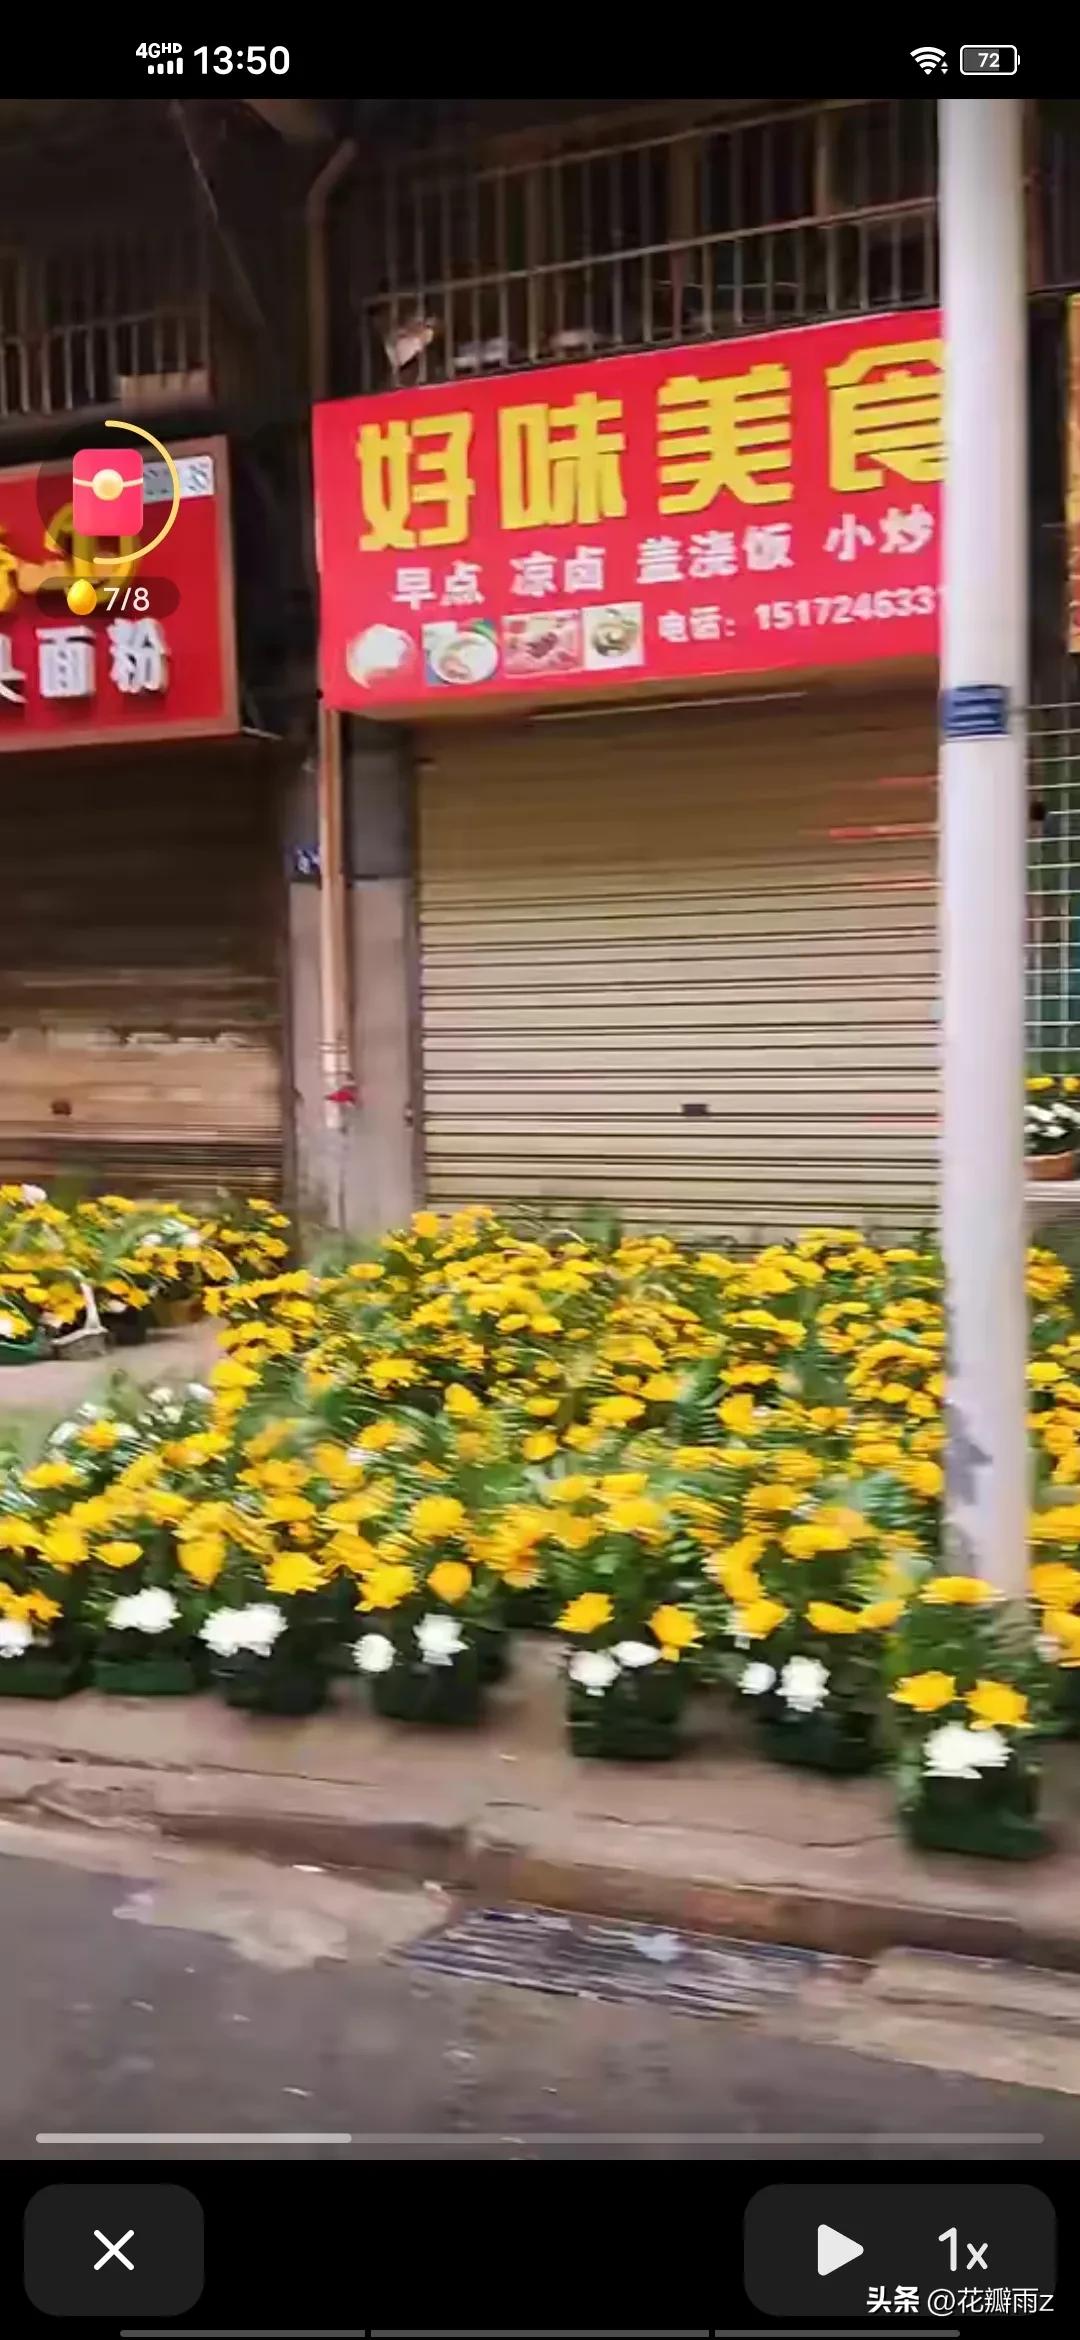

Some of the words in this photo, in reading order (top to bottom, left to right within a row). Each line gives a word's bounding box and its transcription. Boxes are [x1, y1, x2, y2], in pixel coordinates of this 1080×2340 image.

[355, 338, 946, 553] 好味美食
[390, 559, 485, 610] 早点
[635, 522, 795, 585] 盖浇饭
[822, 503, 935, 562] 小炒
